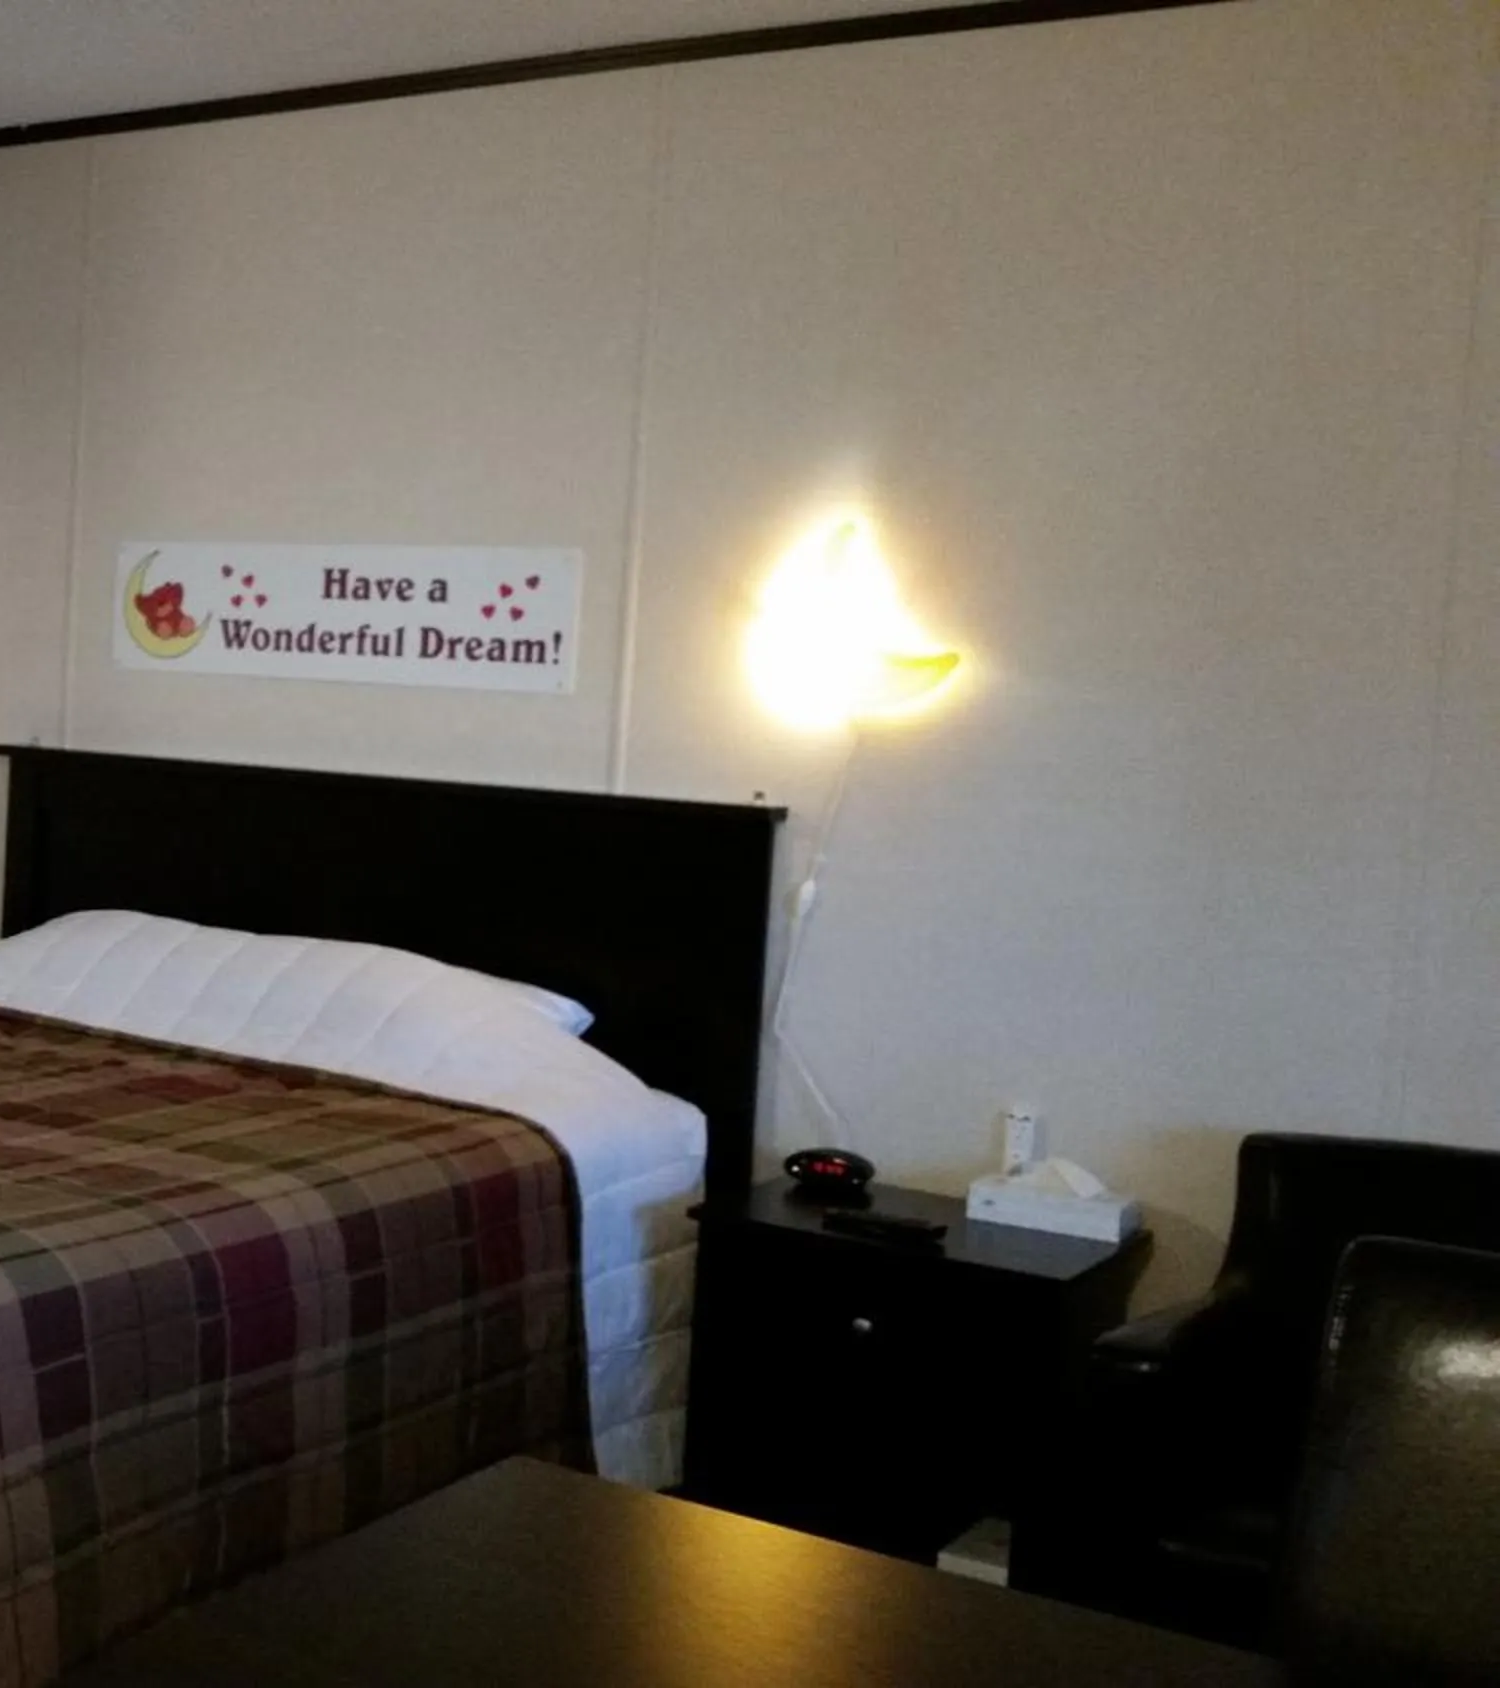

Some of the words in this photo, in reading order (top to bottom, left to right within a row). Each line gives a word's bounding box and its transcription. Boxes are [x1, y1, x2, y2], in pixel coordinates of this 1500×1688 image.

[322, 568, 415, 602] Have
[426, 575, 449, 603] a
[219, 617, 405, 658] Wonderful
[419, 627, 563, 666] Dream!
